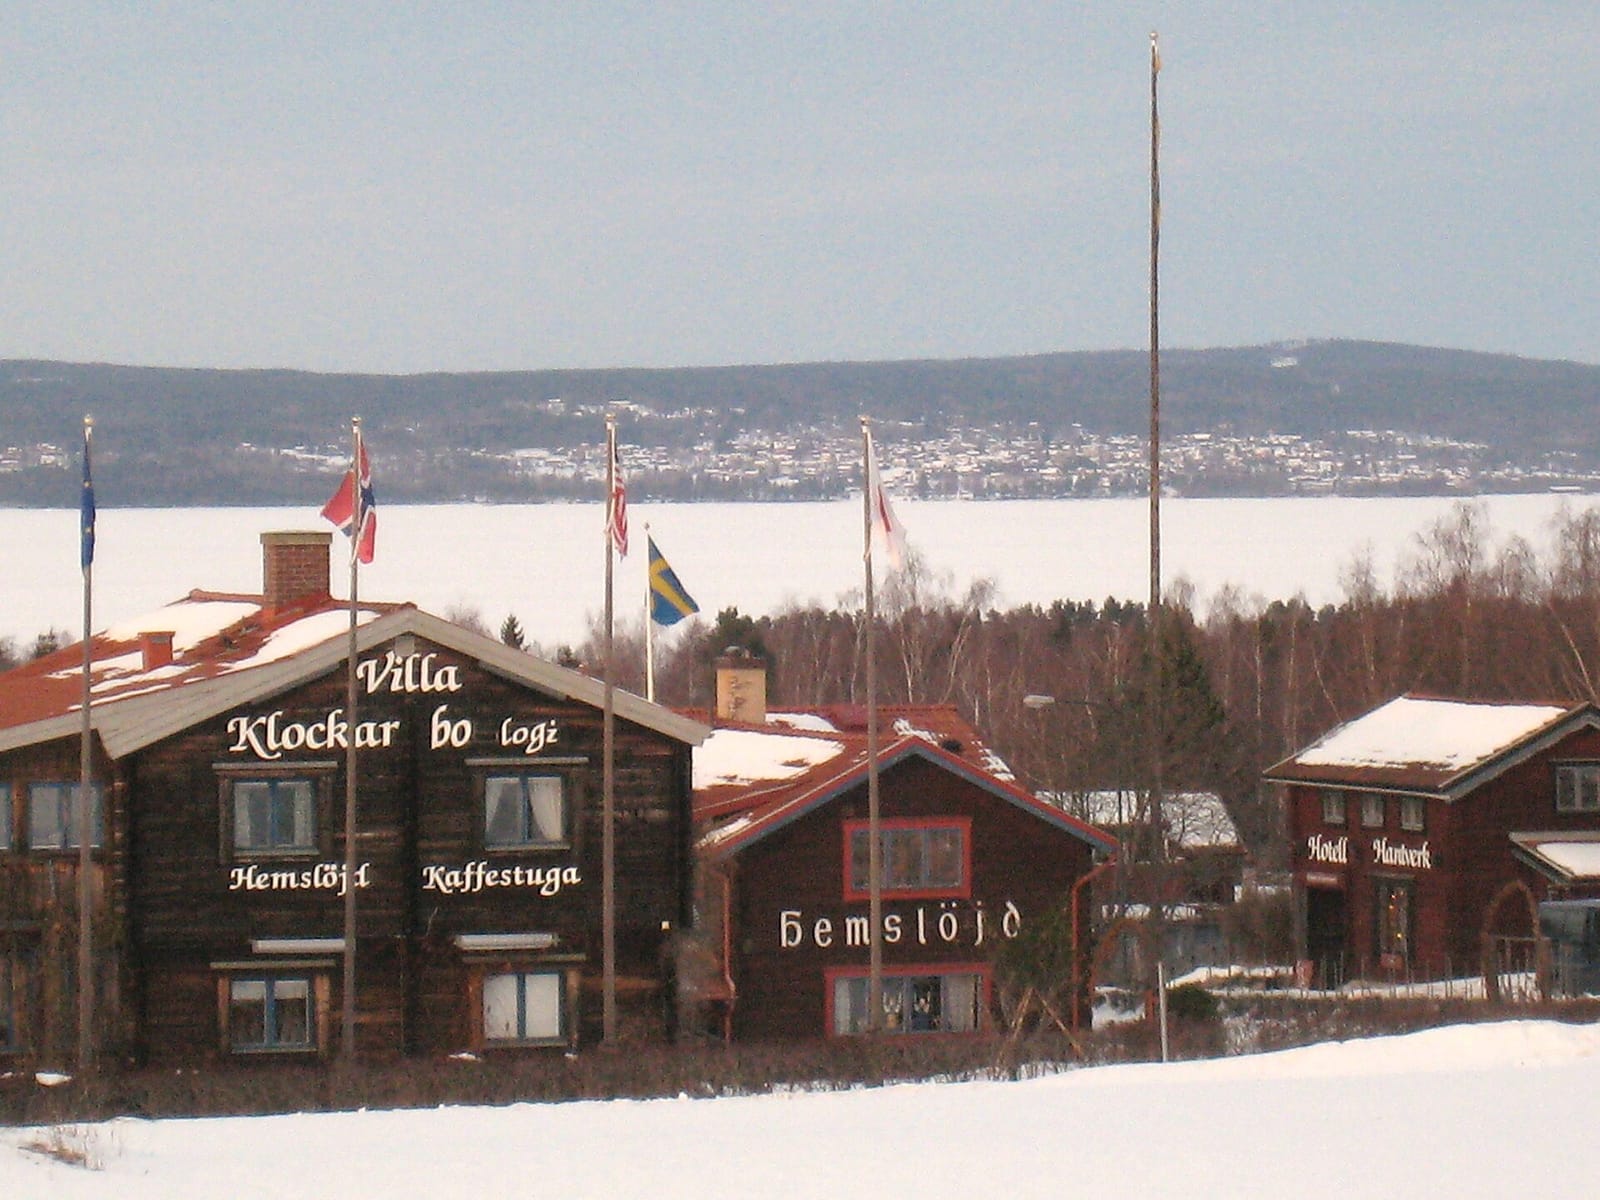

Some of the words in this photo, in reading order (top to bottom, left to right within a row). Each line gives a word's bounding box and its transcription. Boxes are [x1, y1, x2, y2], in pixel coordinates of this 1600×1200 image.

[356, 650, 463, 694] Villa
[227, 709, 400, 760] Klockar
[431, 704, 472, 750] bo
[501, 717, 559, 755] logi
[1307, 834, 1348, 864] Hotell
[1373, 836, 1431, 869] Hantverk
[229, 862, 371, 896] Hemslöjd
[422, 861, 582, 896] Kaffestuga
